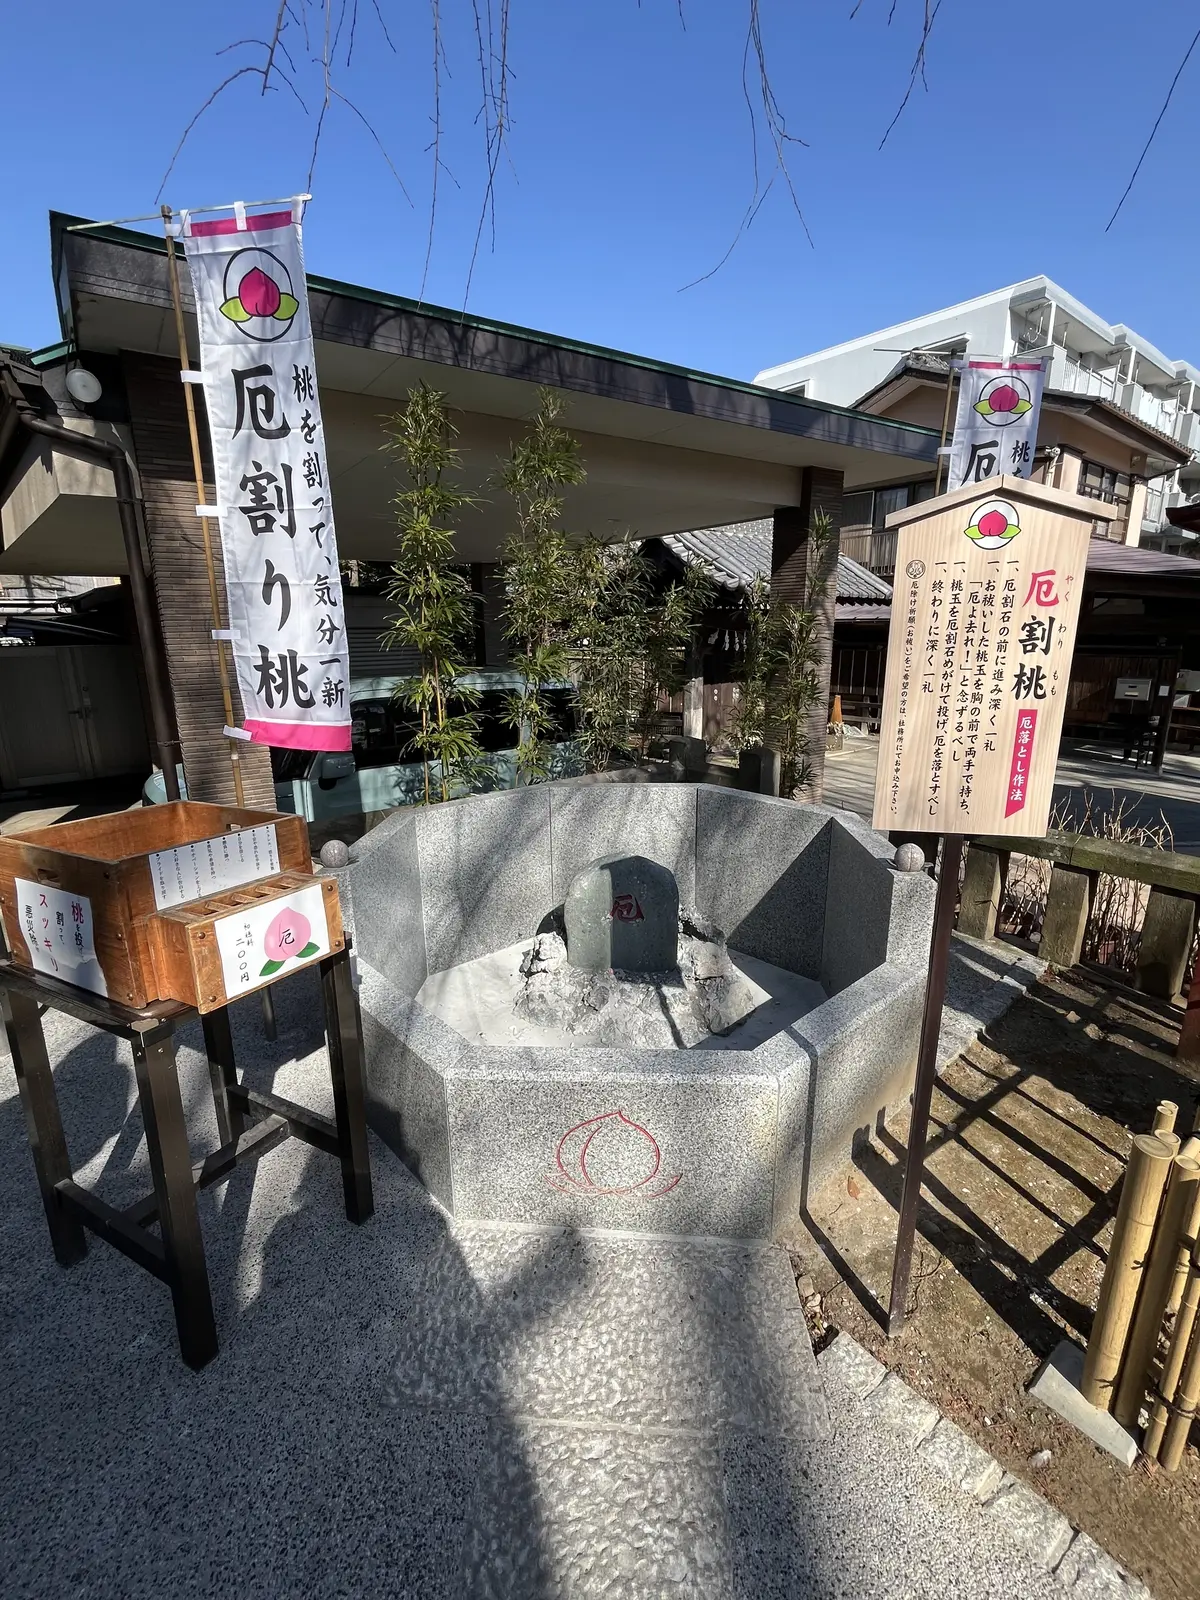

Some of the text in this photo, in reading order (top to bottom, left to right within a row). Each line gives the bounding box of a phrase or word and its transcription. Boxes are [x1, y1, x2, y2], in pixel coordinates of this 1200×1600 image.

[961, 440, 1000, 487] 厄
[231, 363, 317, 710] 厄割り桃
[292, 363, 345, 709] 桃を割って、気分一新
[1063, 574, 1076, 603] やく
[1011, 569, 1060, 700] 厄割桃
[1058, 623, 1067, 650] わり
[1050, 670, 1059, 696] もも
[1010, 716, 1033, 801] 厄落とし作法
[604, 894, 645, 923] 厄
[39, 894, 59, 972] スッキリ
[279, 928, 295, 948] 厄
